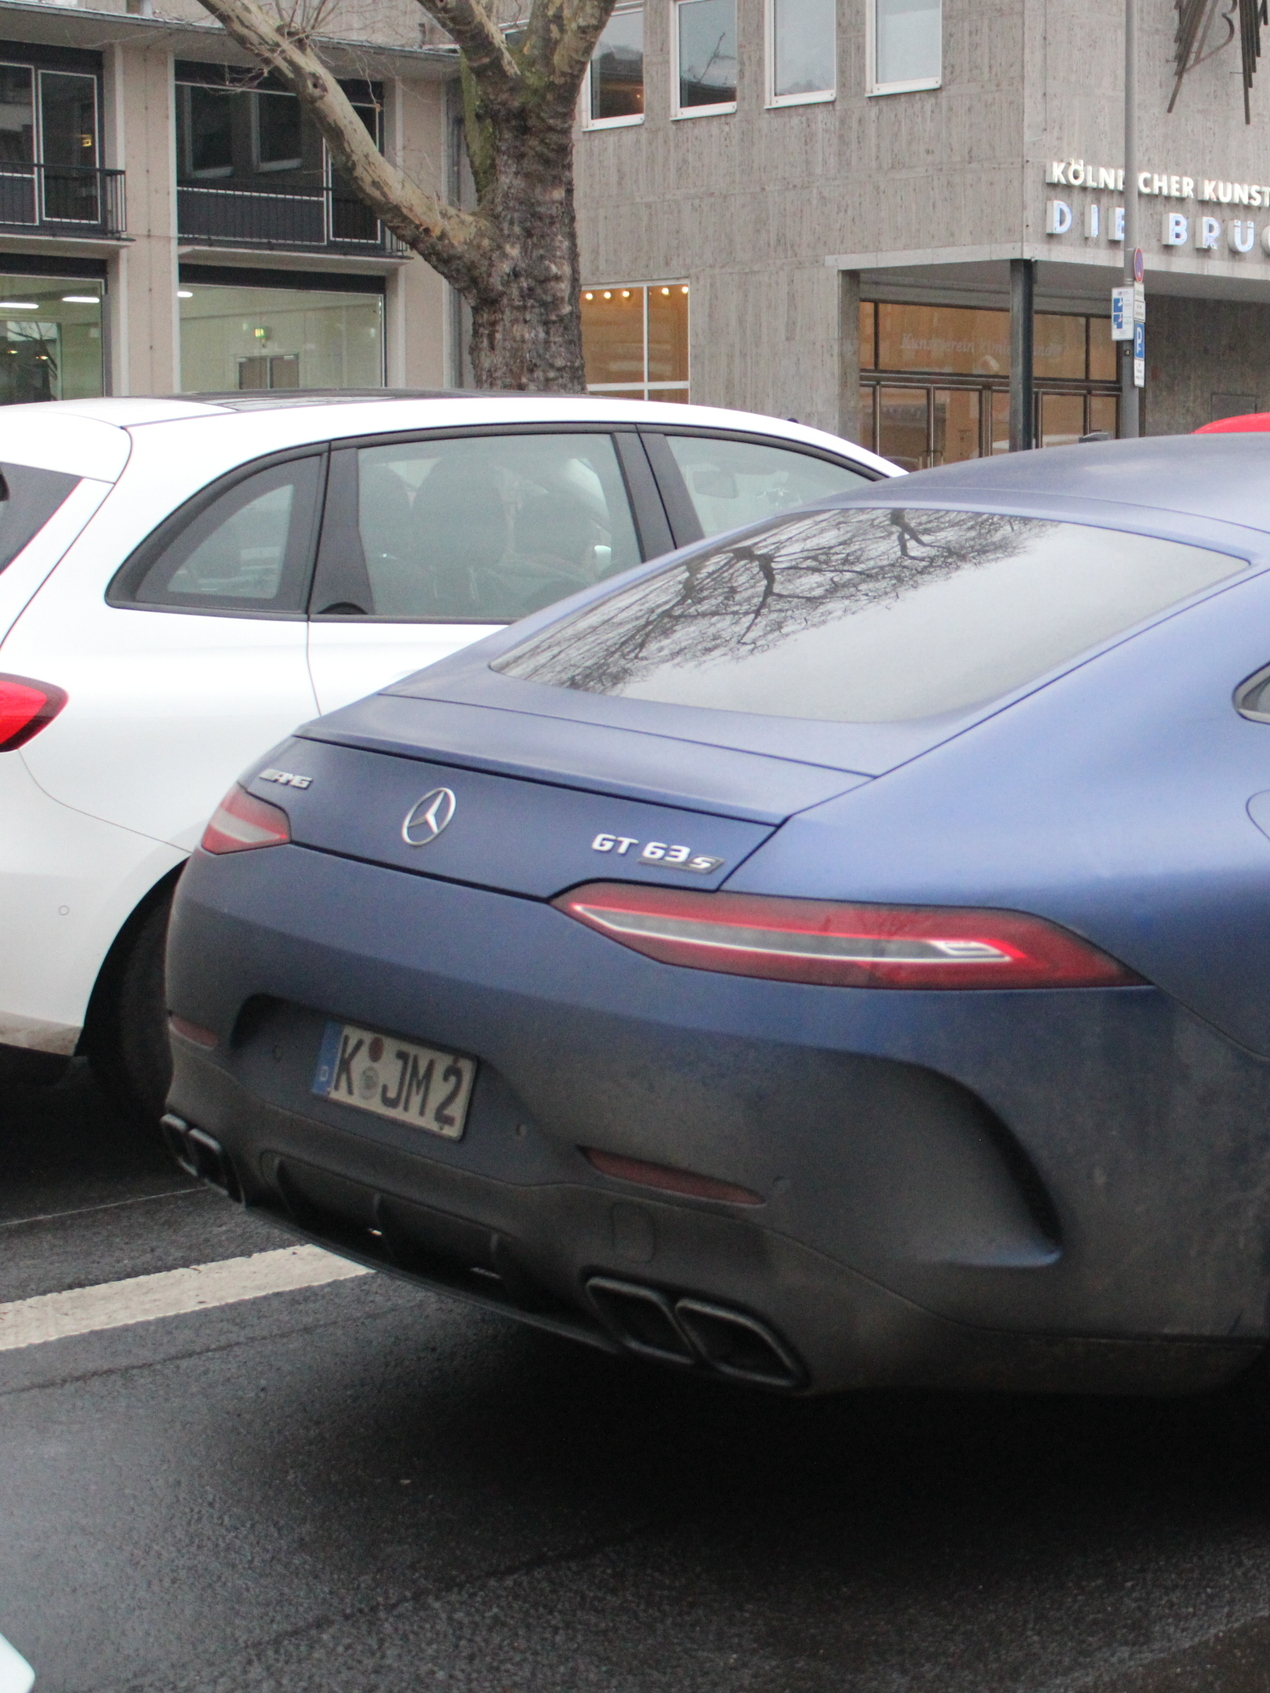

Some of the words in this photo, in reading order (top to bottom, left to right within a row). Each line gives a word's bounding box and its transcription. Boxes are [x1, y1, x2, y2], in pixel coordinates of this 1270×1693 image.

[1048, 158, 1194, 198] KÖLNICHER
[1047, 200, 1124, 241] DIE
[263, 769, 313, 789] AMG
[591, 833, 639, 854] GT
[333, 1034, 365, 1096] K
[380, 1051, 435, 1117] JM
[434, 1063, 463, 1127] 2
